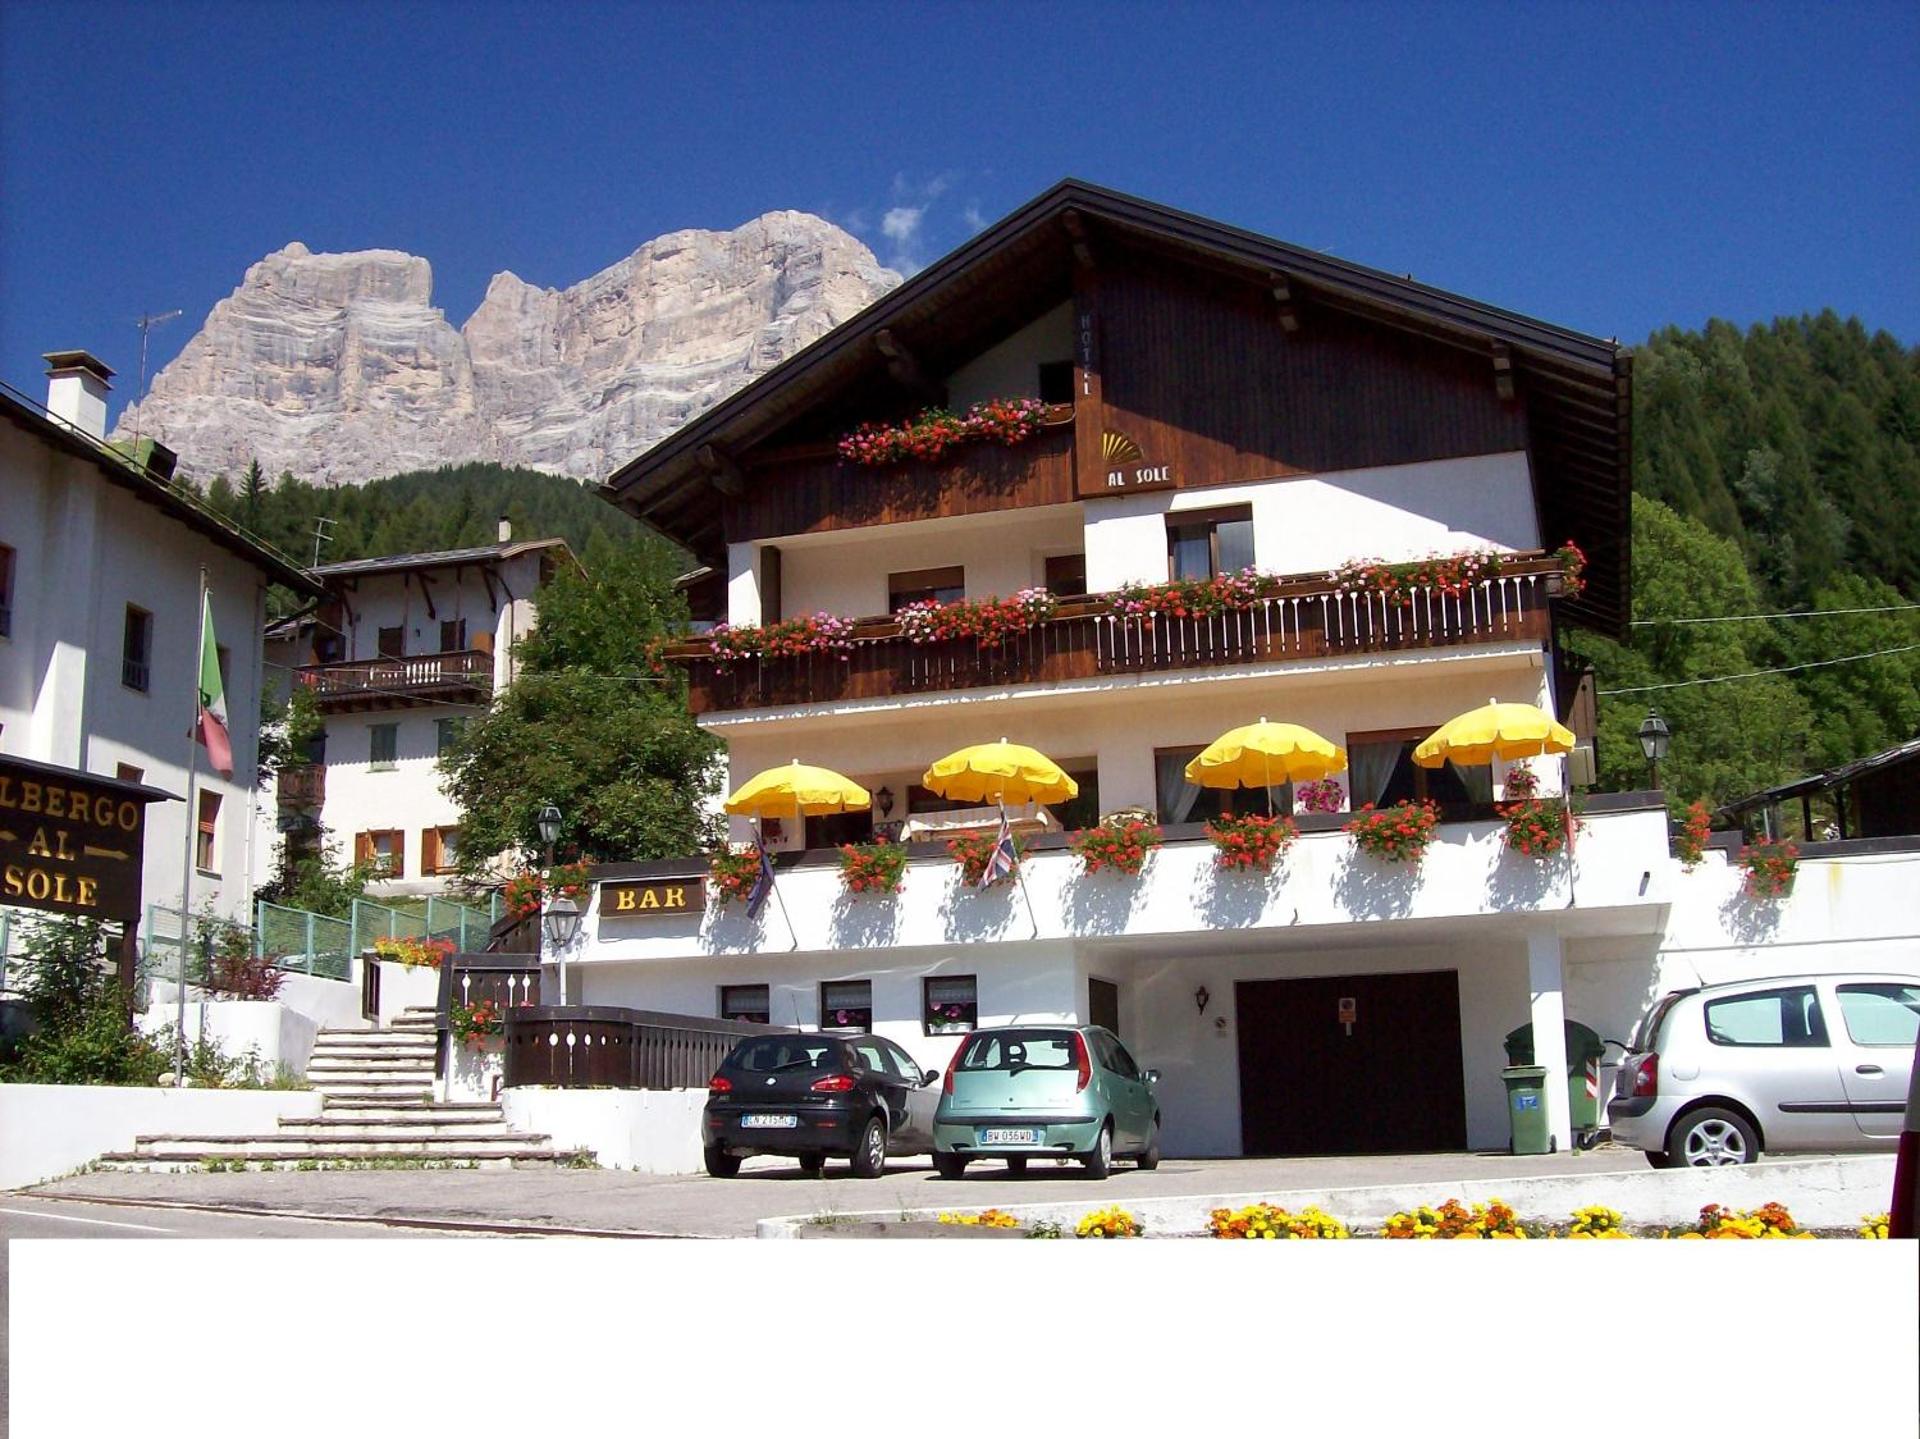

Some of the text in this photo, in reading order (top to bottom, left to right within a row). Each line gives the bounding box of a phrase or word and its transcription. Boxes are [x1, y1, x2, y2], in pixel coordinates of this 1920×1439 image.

[1108, 466, 1170, 487] AL SOLE
[0, 776, 138, 831] LBERGO
[28, 826, 75, 861] AL
[5, 865, 97, 906] SOLE
[616, 887, 686, 910] BAR
